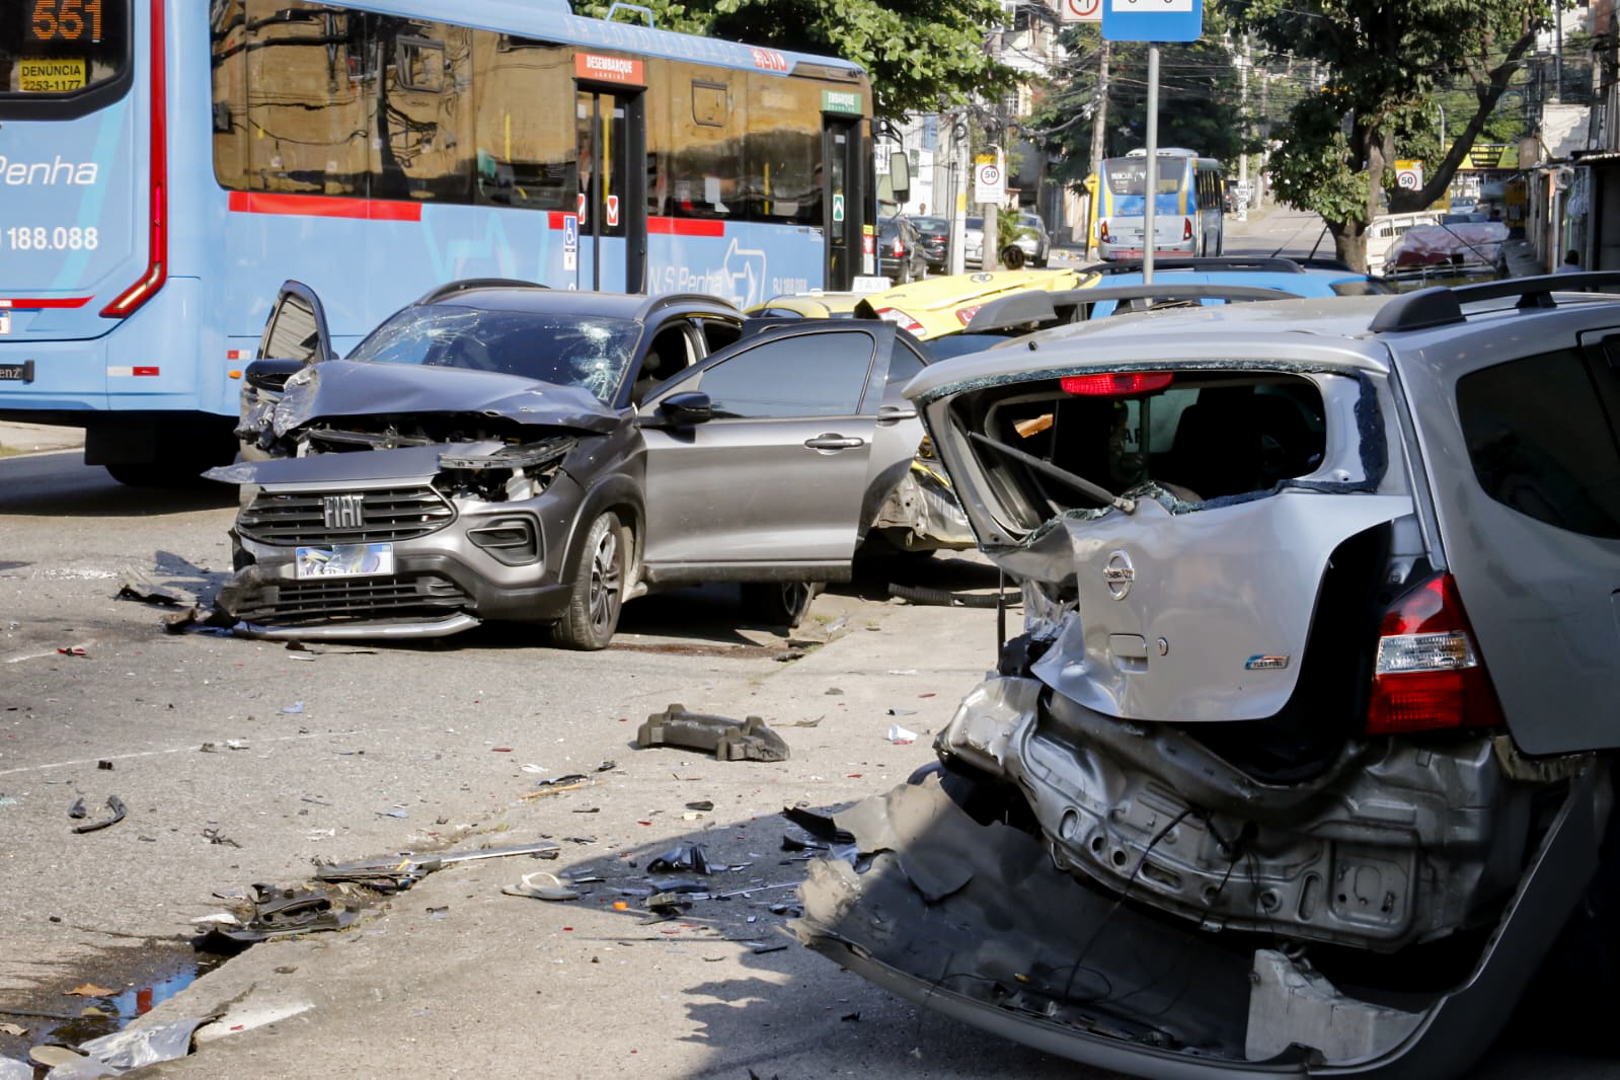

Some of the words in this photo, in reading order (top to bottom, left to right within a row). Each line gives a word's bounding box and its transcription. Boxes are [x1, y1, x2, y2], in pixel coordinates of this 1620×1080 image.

[32, 0, 101, 40] 551
[586, 55, 633, 74] DESEMBARQUE
[984, 170, 996, 179] 50
[1401, 176, 1413, 185] 50
[7, 227, 98, 250] 188.088
[857, 279, 887, 291] TAXI
[323, 495, 364, 528] FIAT
